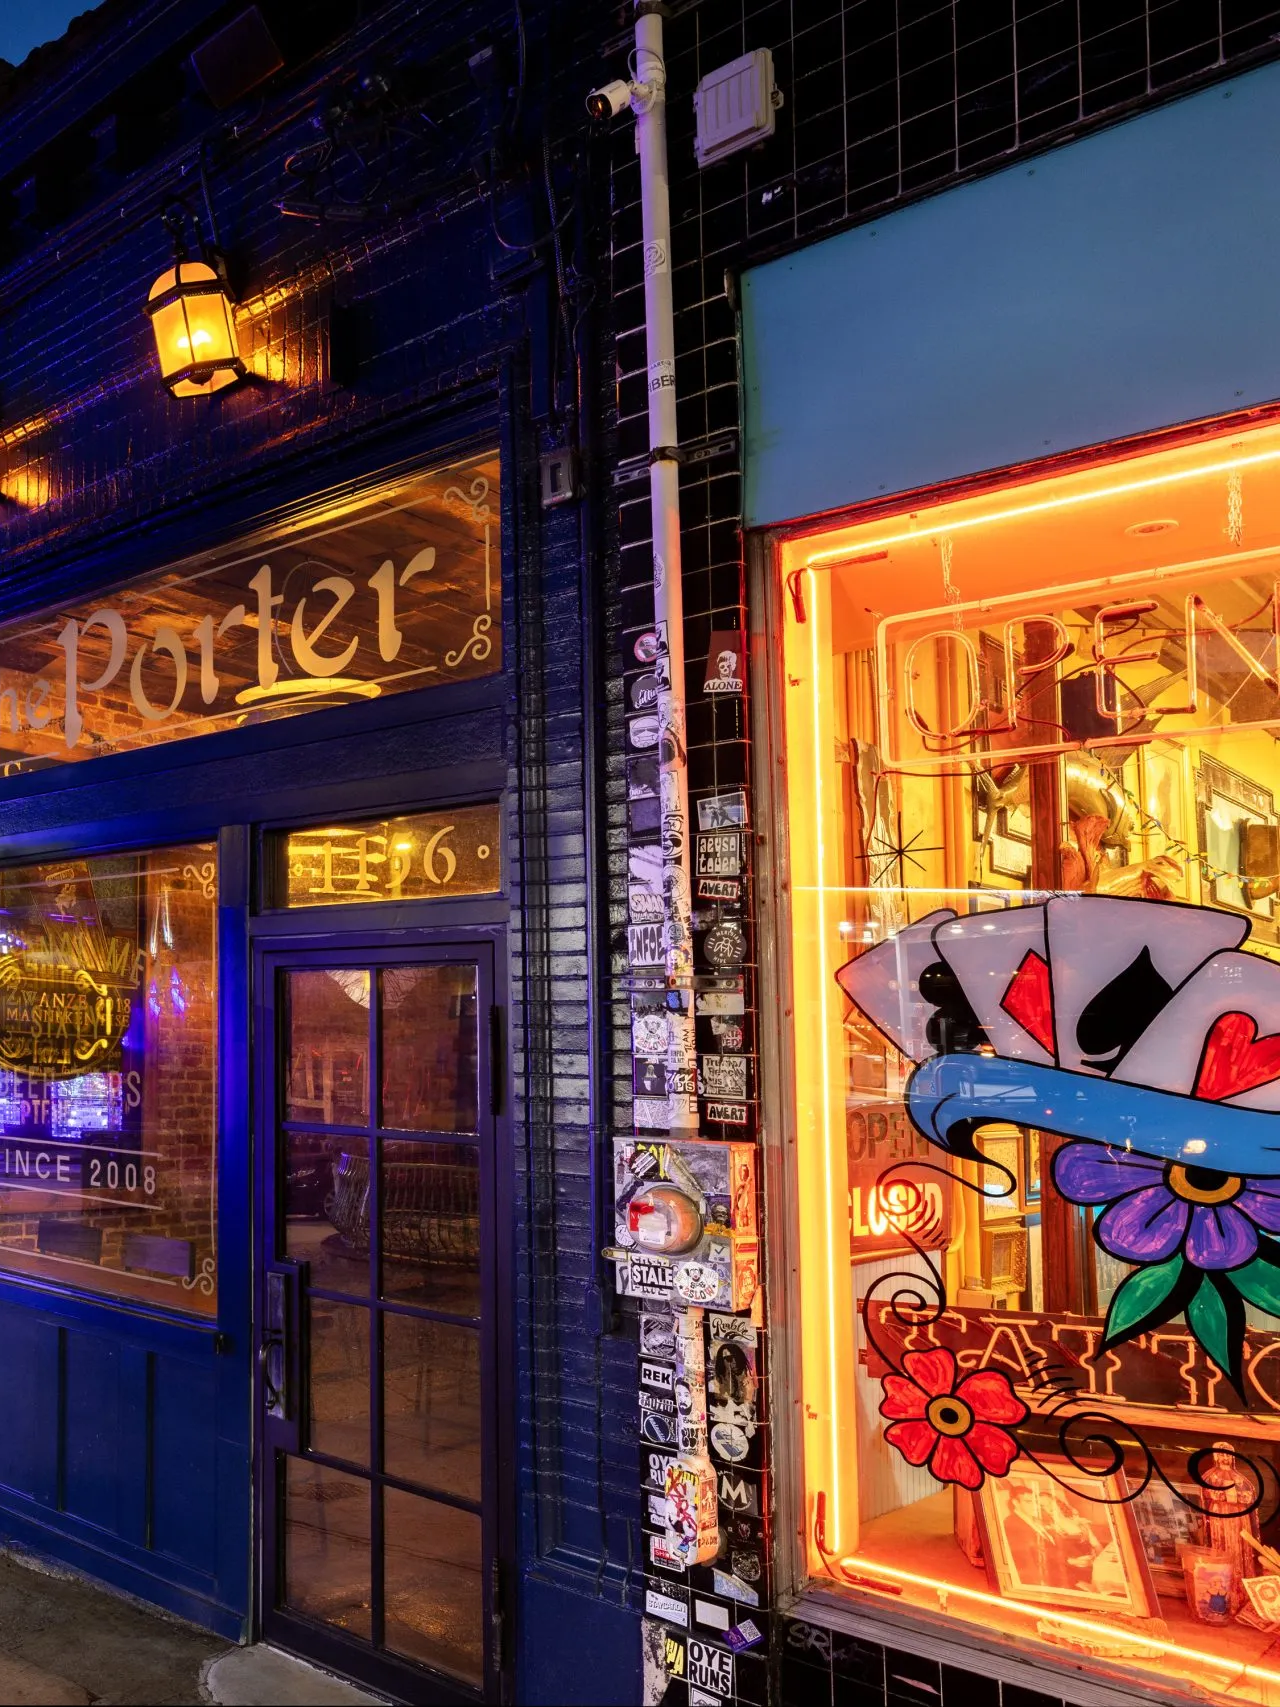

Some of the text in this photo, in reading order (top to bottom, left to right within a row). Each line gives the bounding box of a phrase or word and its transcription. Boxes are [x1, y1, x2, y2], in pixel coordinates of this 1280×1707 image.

[57, 546, 436, 750] Porter
[904, 580, 1280, 741] OPEN
[703, 680, 743, 690] ALONE
[699, 881, 737, 897] AVERT
[709, 1105, 745, 1121] AVERT
[90, 1158, 156, 1195] 2008
[848, 1183, 943, 1237] LOSED
[632, 1264, 674, 1288] STALE
[683, 1285, 715, 1300] 2SLOW
[643, 1367, 671, 1385] REK
[688, 1641, 732, 1675] OYE
[688, 1660, 732, 1696] RUNS
